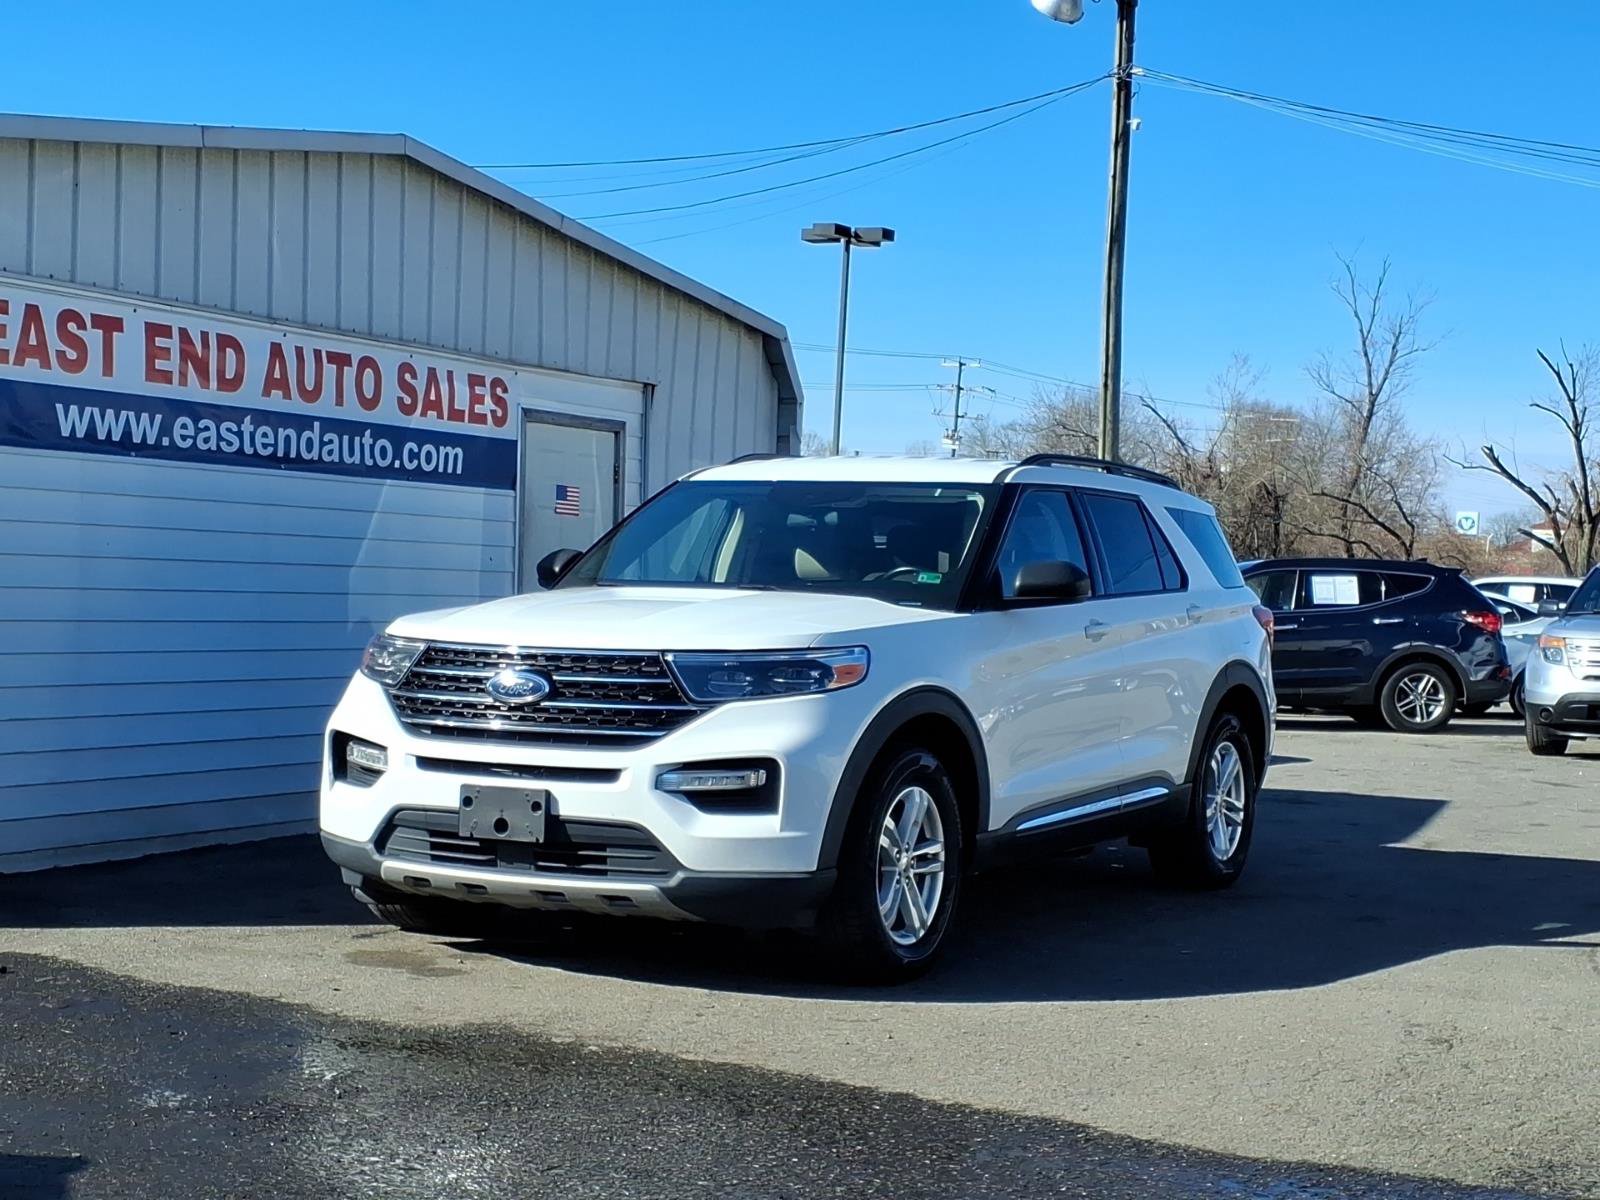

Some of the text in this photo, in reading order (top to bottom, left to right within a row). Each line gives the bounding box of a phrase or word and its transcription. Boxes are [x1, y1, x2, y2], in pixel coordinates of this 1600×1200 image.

[145, 321, 246, 392] END
[262, 342, 383, 411] AUTO
[396, 361, 510, 427] SALES
[55, 403, 464, 474] www.eastendauto.com
